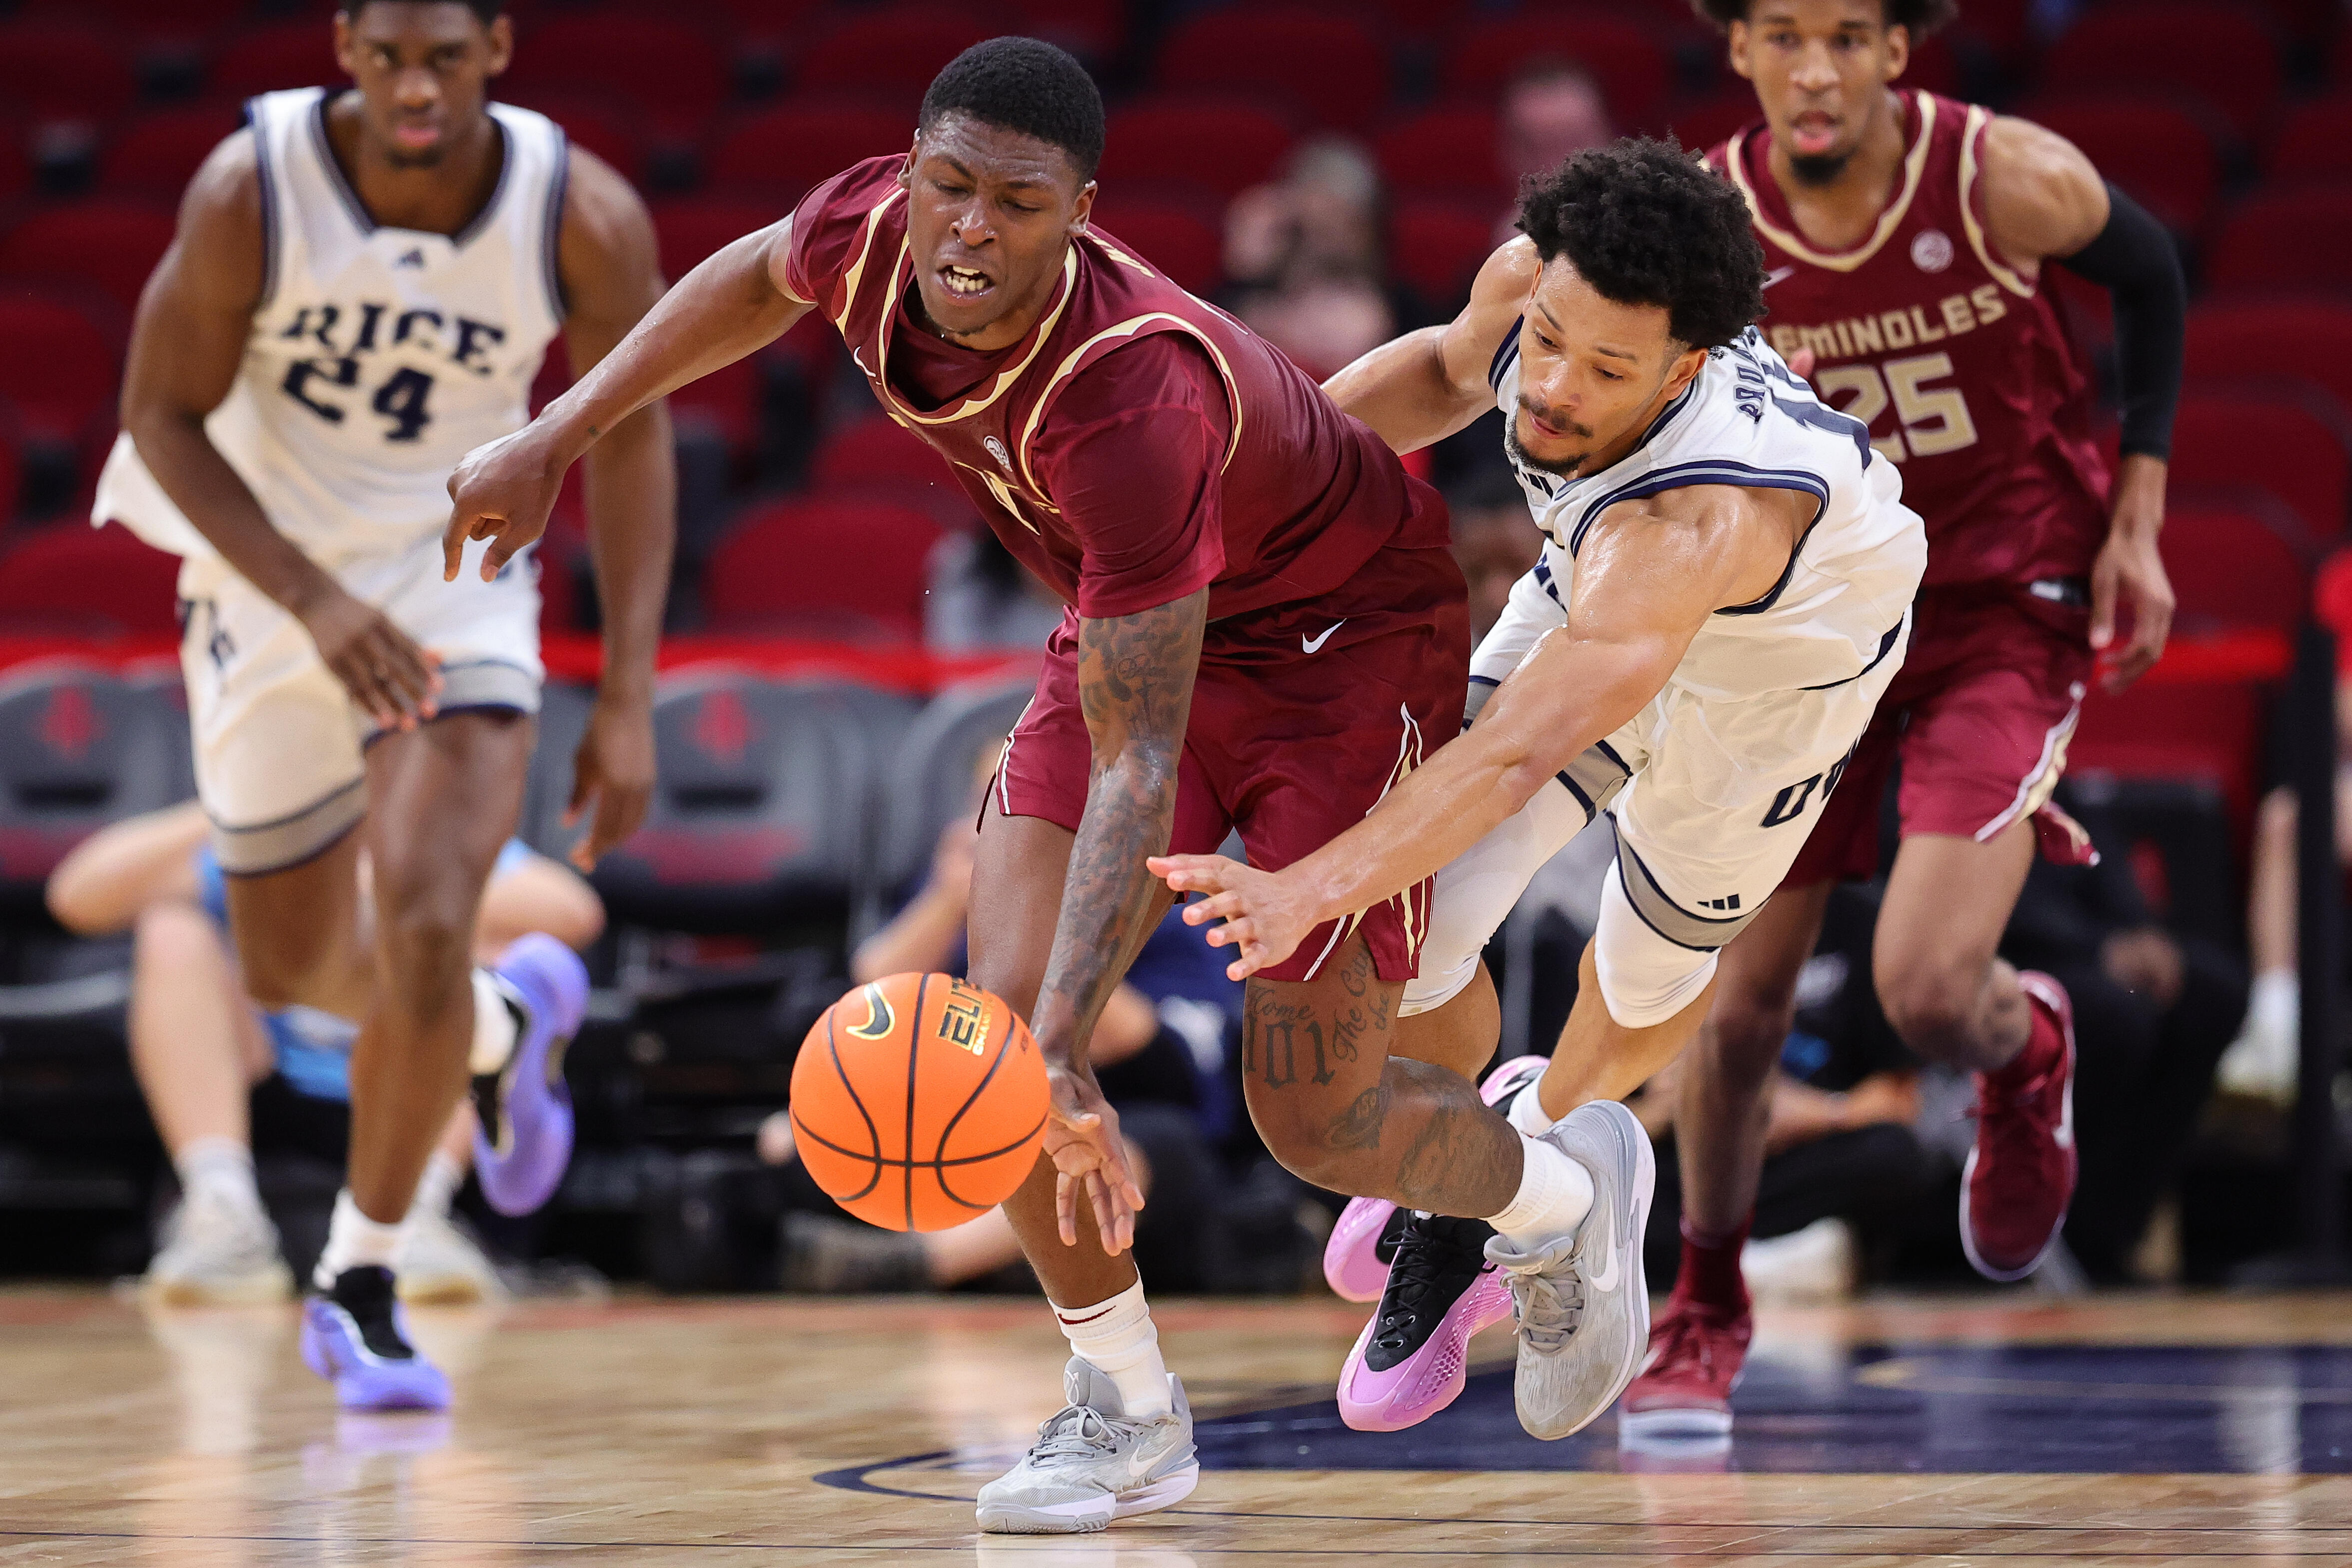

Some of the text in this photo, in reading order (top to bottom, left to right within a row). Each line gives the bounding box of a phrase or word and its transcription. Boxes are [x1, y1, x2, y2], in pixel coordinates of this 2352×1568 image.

[280, 302, 505, 375] RICE
[1769, 282, 2008, 359] EMINOLES
[282, 356, 433, 443] 24
[1816, 351, 1978, 464] 25
